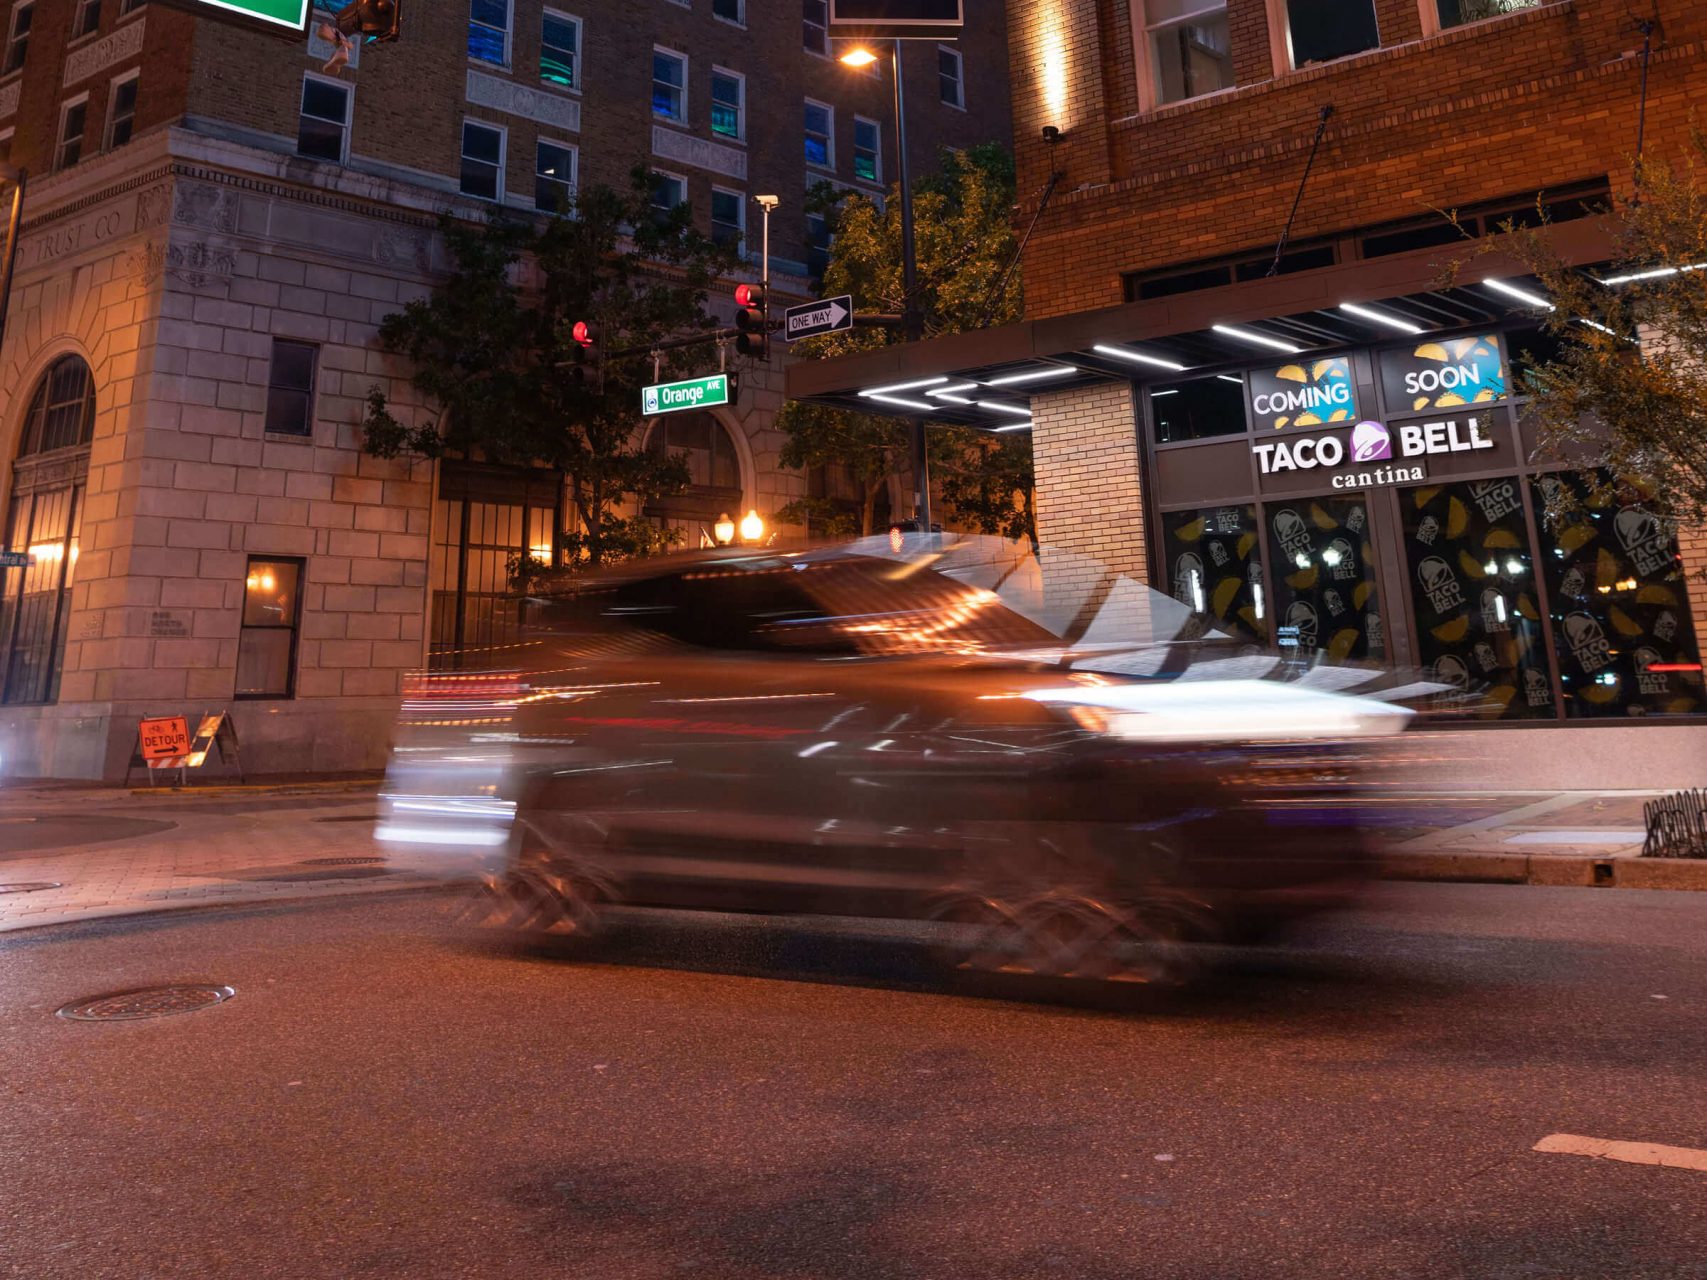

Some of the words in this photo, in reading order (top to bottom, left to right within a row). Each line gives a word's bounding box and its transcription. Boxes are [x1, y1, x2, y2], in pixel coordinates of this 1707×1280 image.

[35, 223, 86, 262] TRUST
[95, 210, 120, 240] CO
[791, 315, 810, 329] ONE
[812, 310, 832, 324] WAY
[1404, 362, 1481, 394] SOON
[662, 385, 703, 405] Orange
[706, 379, 721, 391] AVE
[1253, 382, 1350, 415] COMING
[1252, 436, 1343, 474] TACO
[1399, 418, 1494, 457] BELL
[1331, 465, 1424, 489] cantina
[1475, 484, 1513, 510] TACO
[1484, 497, 1521, 523] BELL
[1280, 532, 1311, 554] TACO
[1426, 581, 1460, 603] TACO
[1434, 592, 1467, 614] BELL
[1573, 639, 1609, 661] TACO
[1635, 674, 1667, 684] TACO
[1640, 683, 1669, 695] BELL
[1525, 689, 1549, 699] TACO
[144, 734, 185, 747] DETOUR
